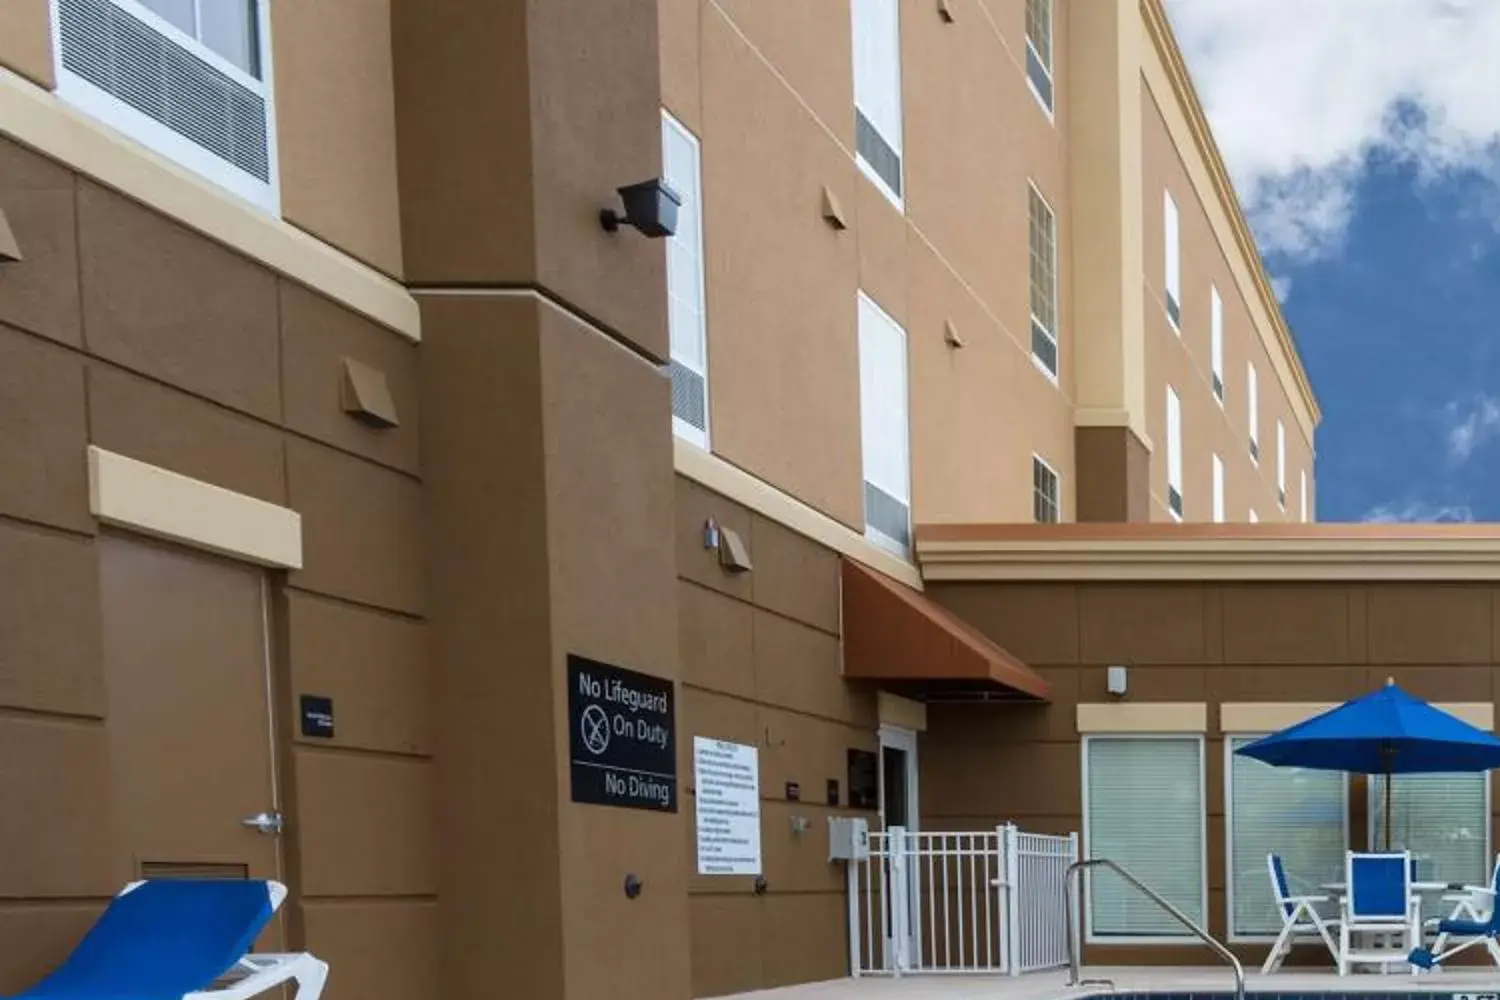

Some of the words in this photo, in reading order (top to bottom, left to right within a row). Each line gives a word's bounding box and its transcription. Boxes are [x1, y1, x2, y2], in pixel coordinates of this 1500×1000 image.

[579, 672, 600, 698] No
[604, 679, 668, 713] Lifeguard
[613, 714, 634, 738] On
[637, 719, 669, 749] Duty
[605, 771, 626, 796] No
[629, 775, 670, 806] Diving
